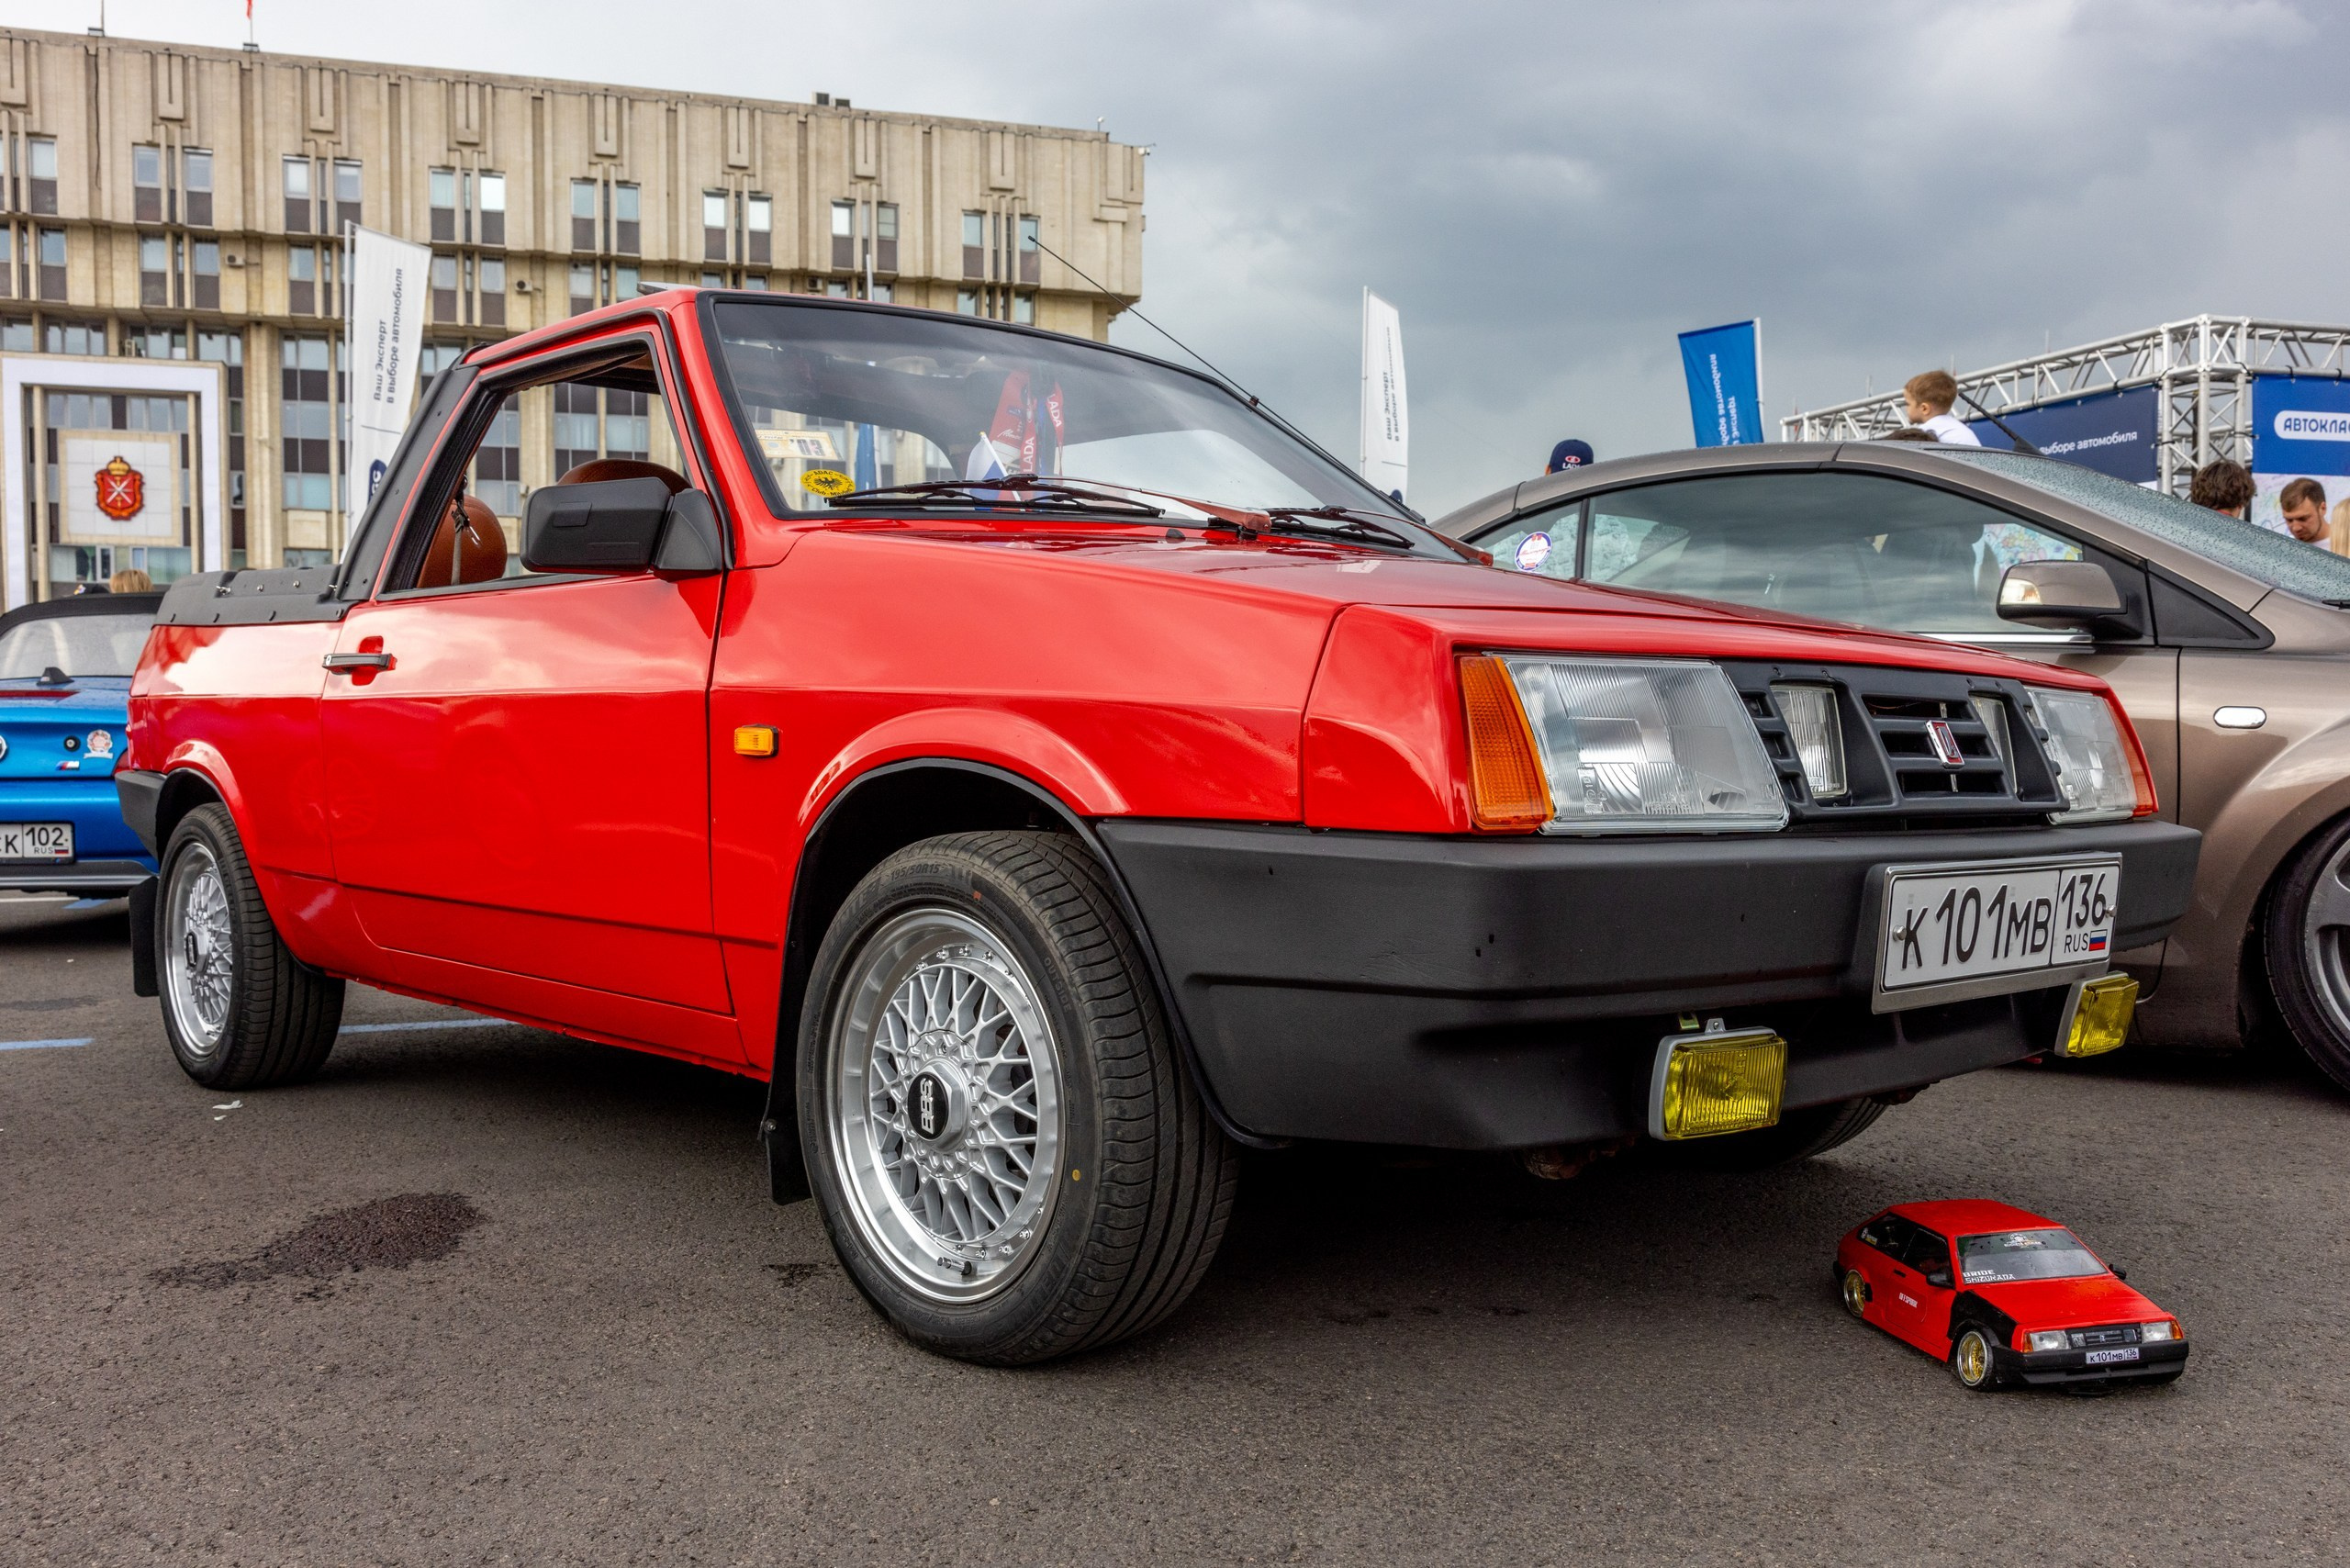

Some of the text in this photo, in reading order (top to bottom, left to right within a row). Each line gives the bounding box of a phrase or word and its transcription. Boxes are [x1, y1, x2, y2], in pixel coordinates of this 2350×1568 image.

[392, 267, 403, 343] автомобиля
[374, 319, 387, 400] Ваш Эксперт
[387, 345, 399, 393] выборе
[1046, 393, 1063, 428] LADA
[2283, 417, 2350, 434] АВТОКЛА
[1023, 436, 1035, 473] LADA
[2076, 431, 2138, 451] автомобиля
[0, 827, 64, 855] К 102
[34, 846, 54, 855] RUS
[2061, 872, 2106, 930] 136
[2064, 932, 2089, 954] RUS
[1044, 957, 1072, 1012] OUTSIDE
[920, 1077, 934, 1135] BBS
[1963, 1269, 1996, 1278] BRIDE
[2125, 1349, 2137, 1357] 136
